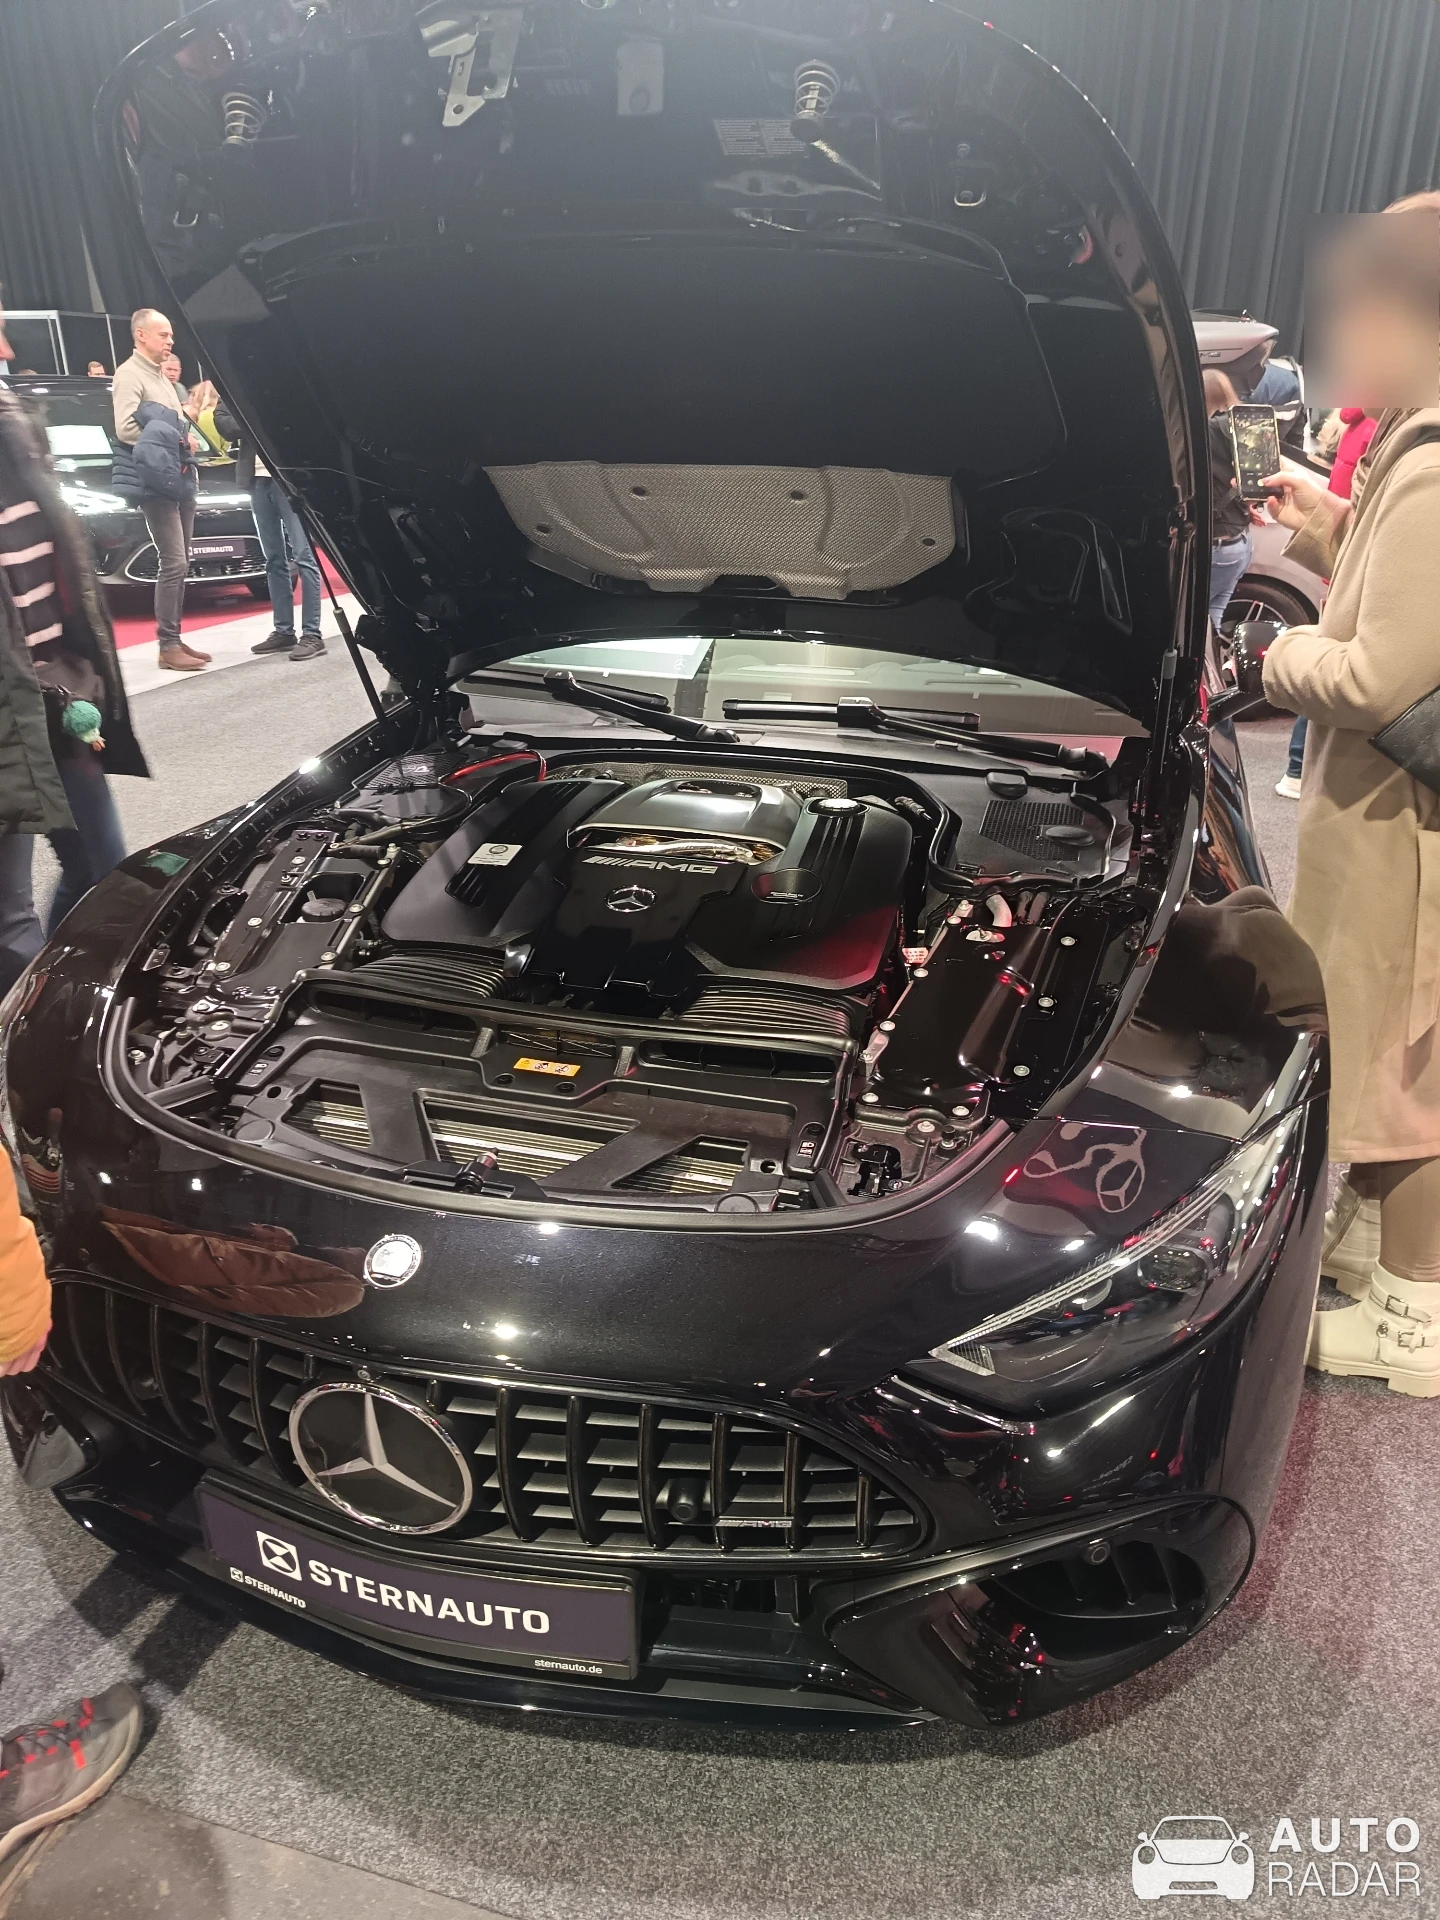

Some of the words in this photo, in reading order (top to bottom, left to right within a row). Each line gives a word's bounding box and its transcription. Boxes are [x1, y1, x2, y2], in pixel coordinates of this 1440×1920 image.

[193, 545, 234, 554] STERNAUTO
[626, 859, 718, 875] AMG
[739, 1520, 792, 1528] AMG
[244, 1575, 306, 1608] STERNAUTO
[308, 1559, 550, 1634] STERNAUTO
[534, 1659, 603, 1674] sternauto.de
